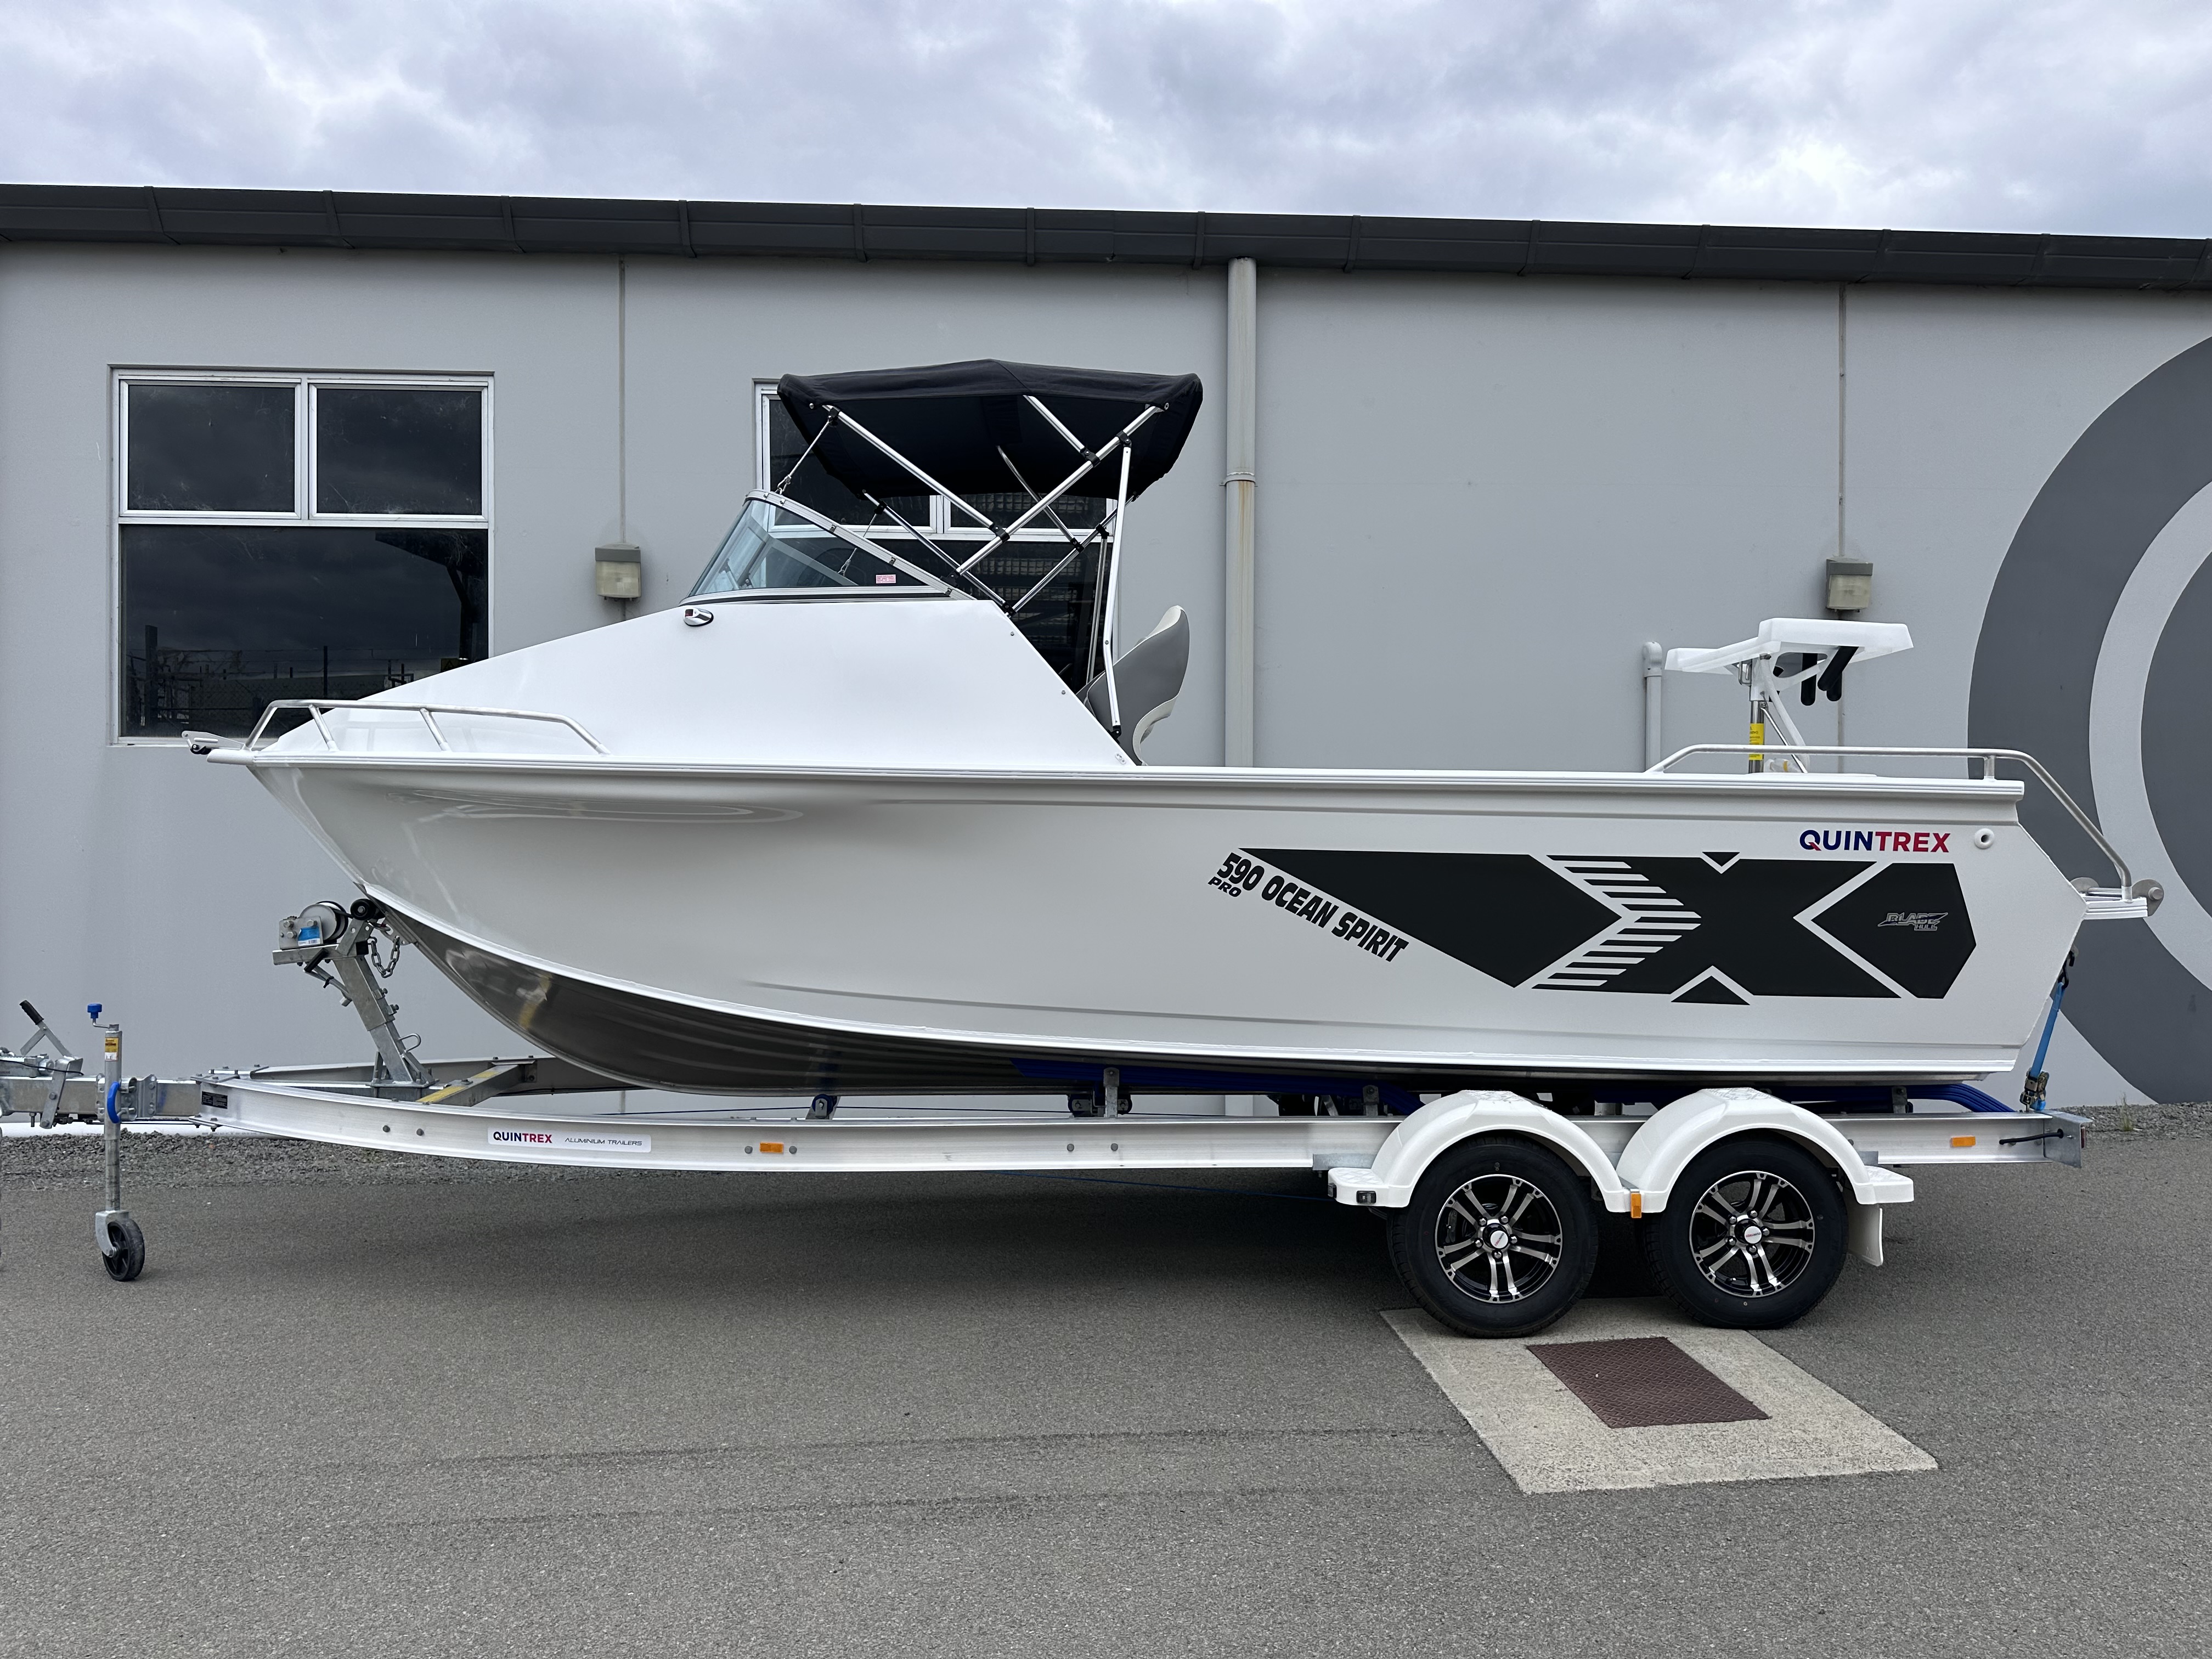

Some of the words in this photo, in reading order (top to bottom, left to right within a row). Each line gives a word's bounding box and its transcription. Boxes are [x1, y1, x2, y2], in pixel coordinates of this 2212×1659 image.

[1799, 830, 1951, 853] QUINTREX
[1207, 876, 1242, 898] PRO
[1216, 852, 1265, 891] 590
[1261, 875, 1339, 928] OCEAN
[1331, 911, 1409, 962] SPIRIT
[493, 1131, 552, 1144] QUINTREX
